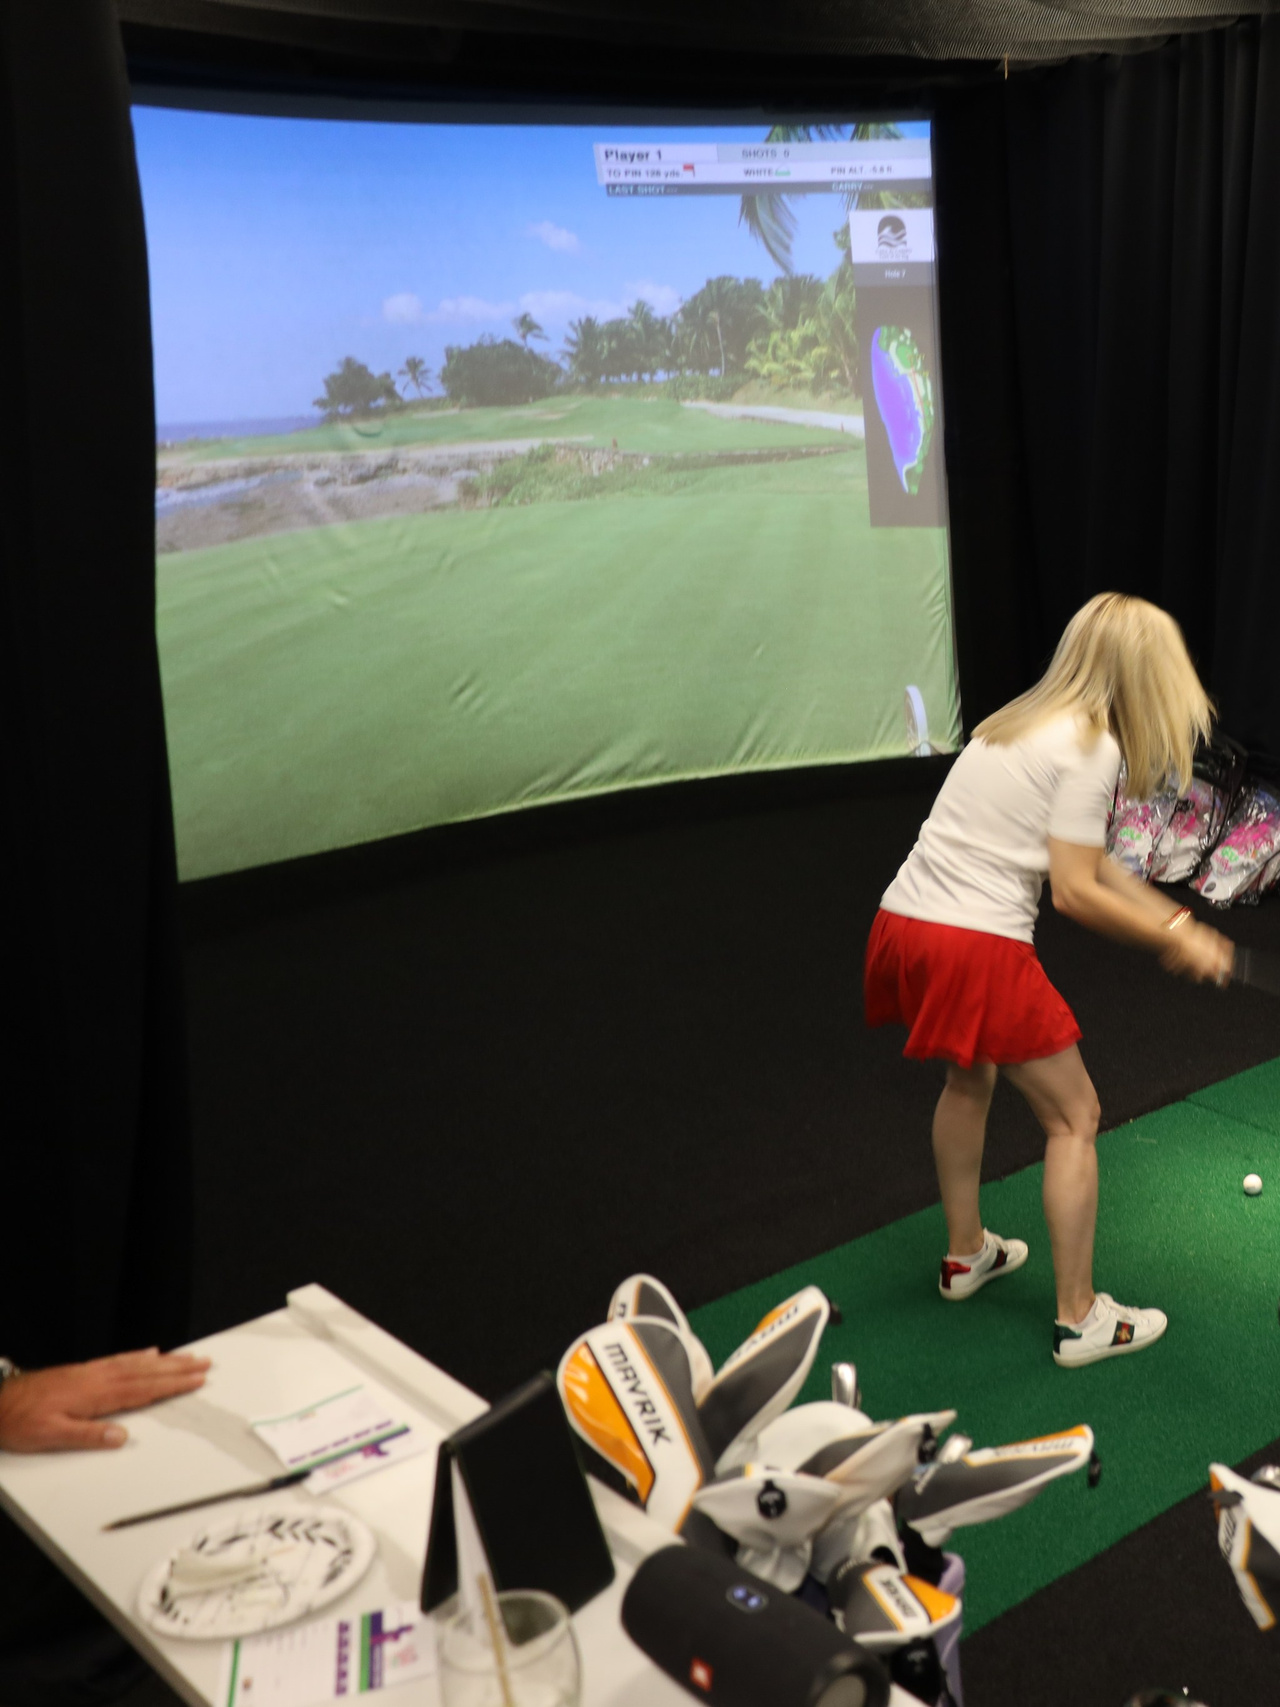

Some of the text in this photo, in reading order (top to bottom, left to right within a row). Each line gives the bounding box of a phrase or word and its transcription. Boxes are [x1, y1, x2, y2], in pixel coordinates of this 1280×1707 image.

[604, 148, 662, 163] Player 1
[741, 149, 777, 159] SHOTS
[607, 168, 621, 178] TO
[624, 168, 642, 178] PIN
[743, 167, 773, 177] WHITE
[608, 184, 665, 195] LAST SHOT
[831, 181, 863, 191] CARRY
[603, 1342, 672, 1446] MAVRIK
